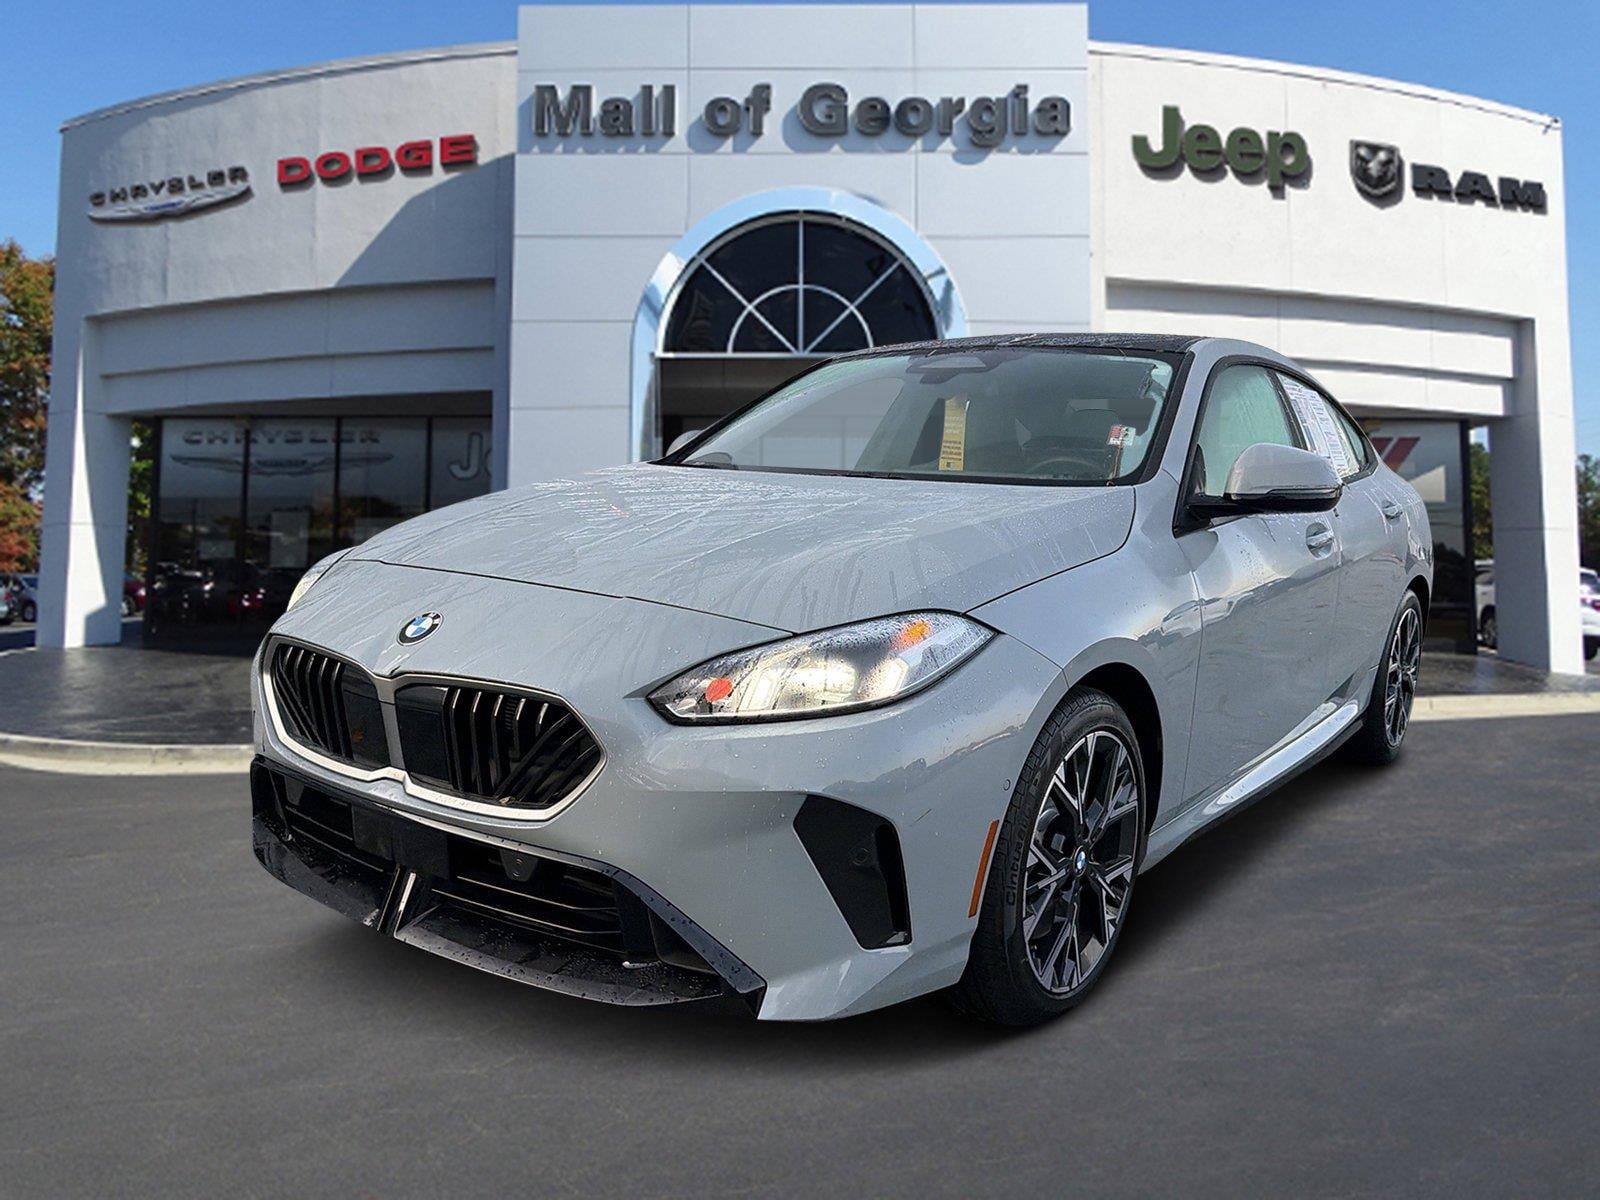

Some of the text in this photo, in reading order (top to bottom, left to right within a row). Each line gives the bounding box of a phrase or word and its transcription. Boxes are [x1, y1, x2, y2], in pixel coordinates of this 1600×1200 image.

[532, 83, 1072, 149] Mall of Georgia
[276, 133, 478, 187] DODGE
[1132, 105, 1310, 192] Jeep
[89, 165, 250, 208] CHRYSLER
[1411, 162, 1547, 215] RAM
[182, 428, 382, 446] CHRYSLER
[449, 431, 492, 482] J
